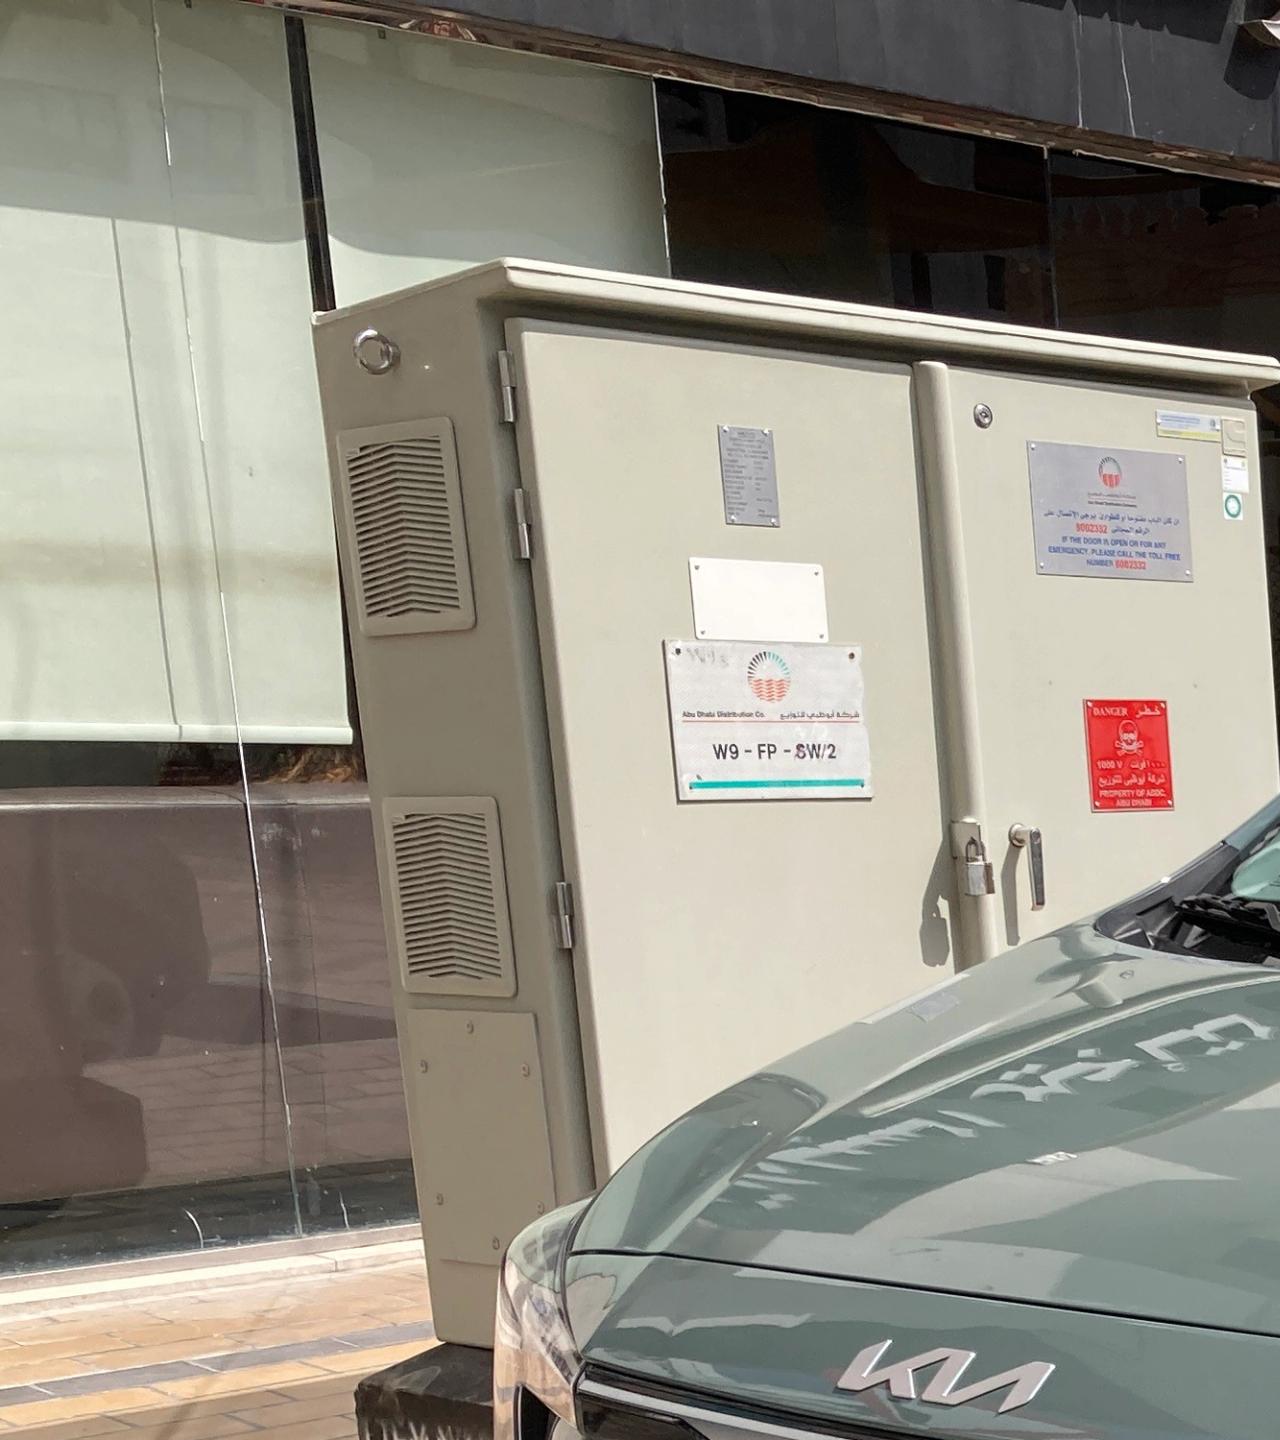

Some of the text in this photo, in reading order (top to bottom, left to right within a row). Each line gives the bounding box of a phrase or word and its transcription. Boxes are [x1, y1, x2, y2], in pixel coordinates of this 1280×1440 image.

[1117, 550, 1133, 558] CALL
[1093, 707, 1128, 717] DANGER
[712, 743, 740, 760] W9
[757, 743, 777, 760] FP
[837, 1338, 1057, 1415] KIA
